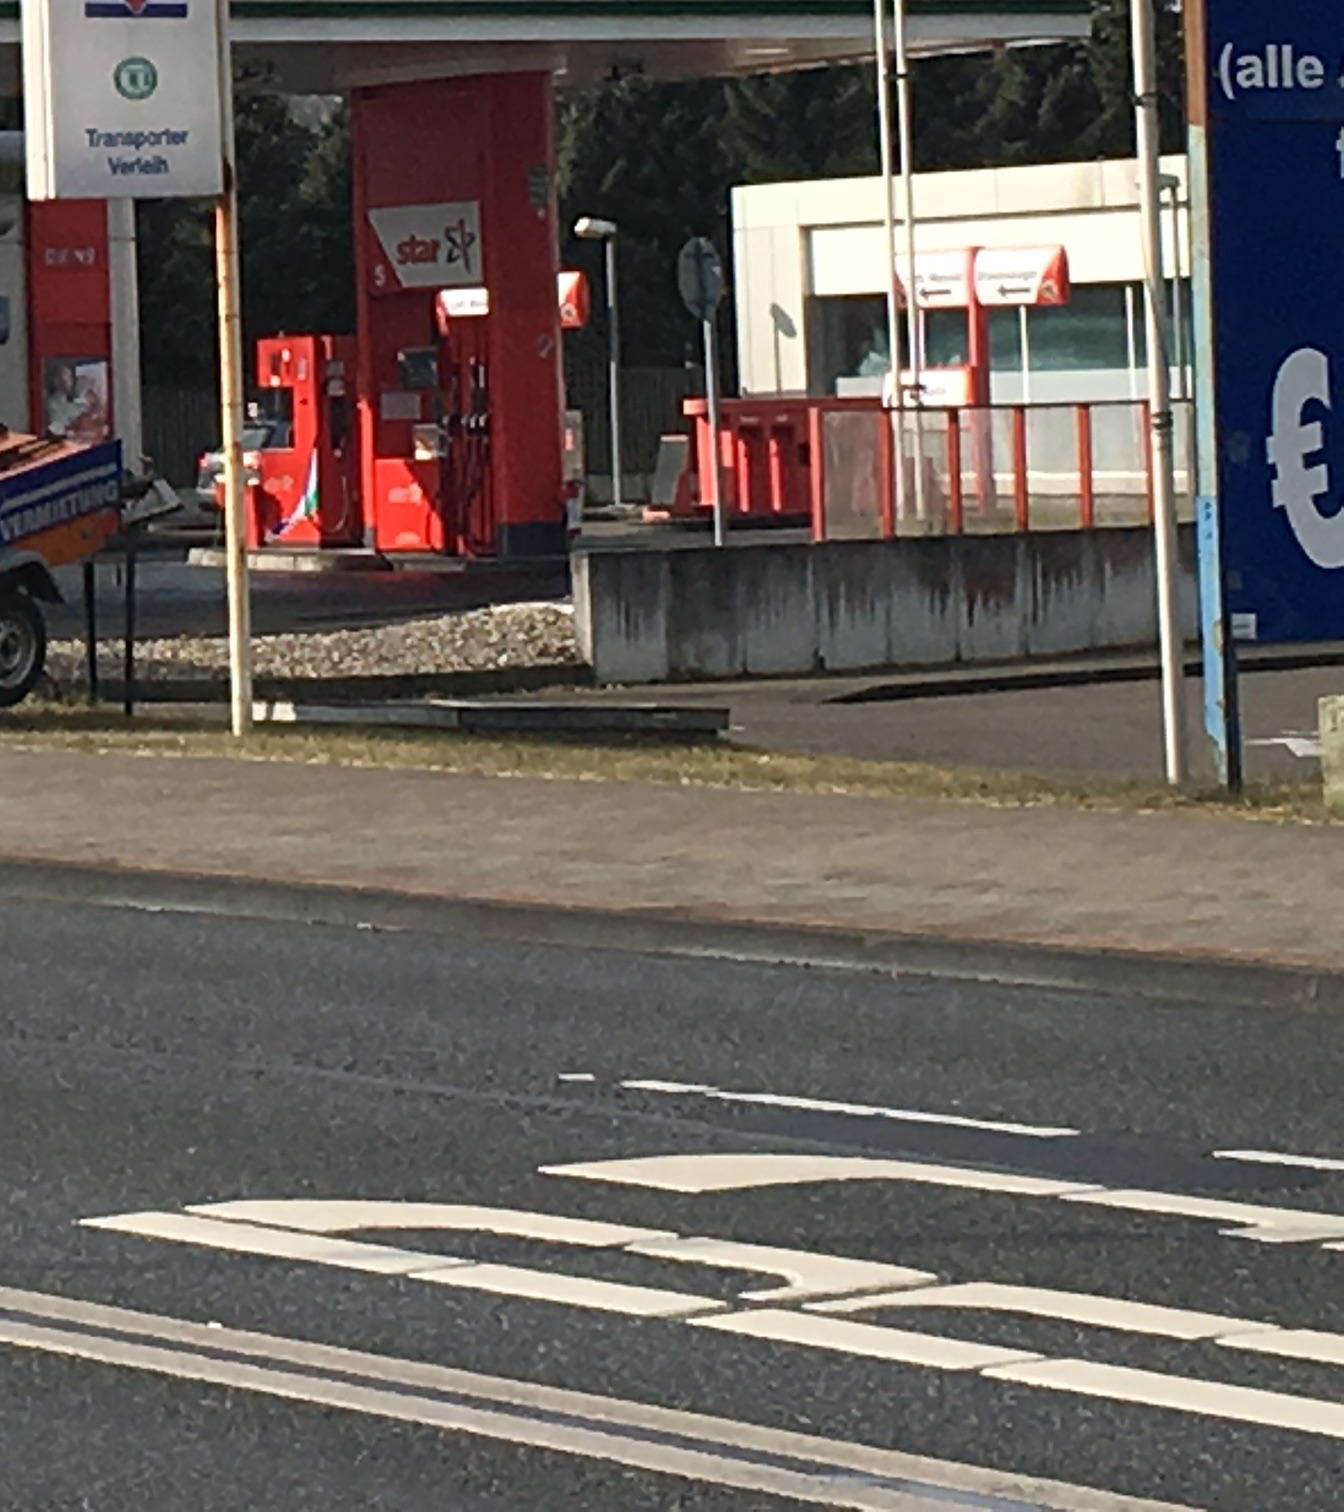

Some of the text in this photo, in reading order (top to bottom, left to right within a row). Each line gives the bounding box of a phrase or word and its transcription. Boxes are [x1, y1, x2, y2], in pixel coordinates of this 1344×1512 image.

[1219, 42, 1324, 100] (alle
[85, 128, 189, 150] Transporter
[396, 234, 440, 265] star
